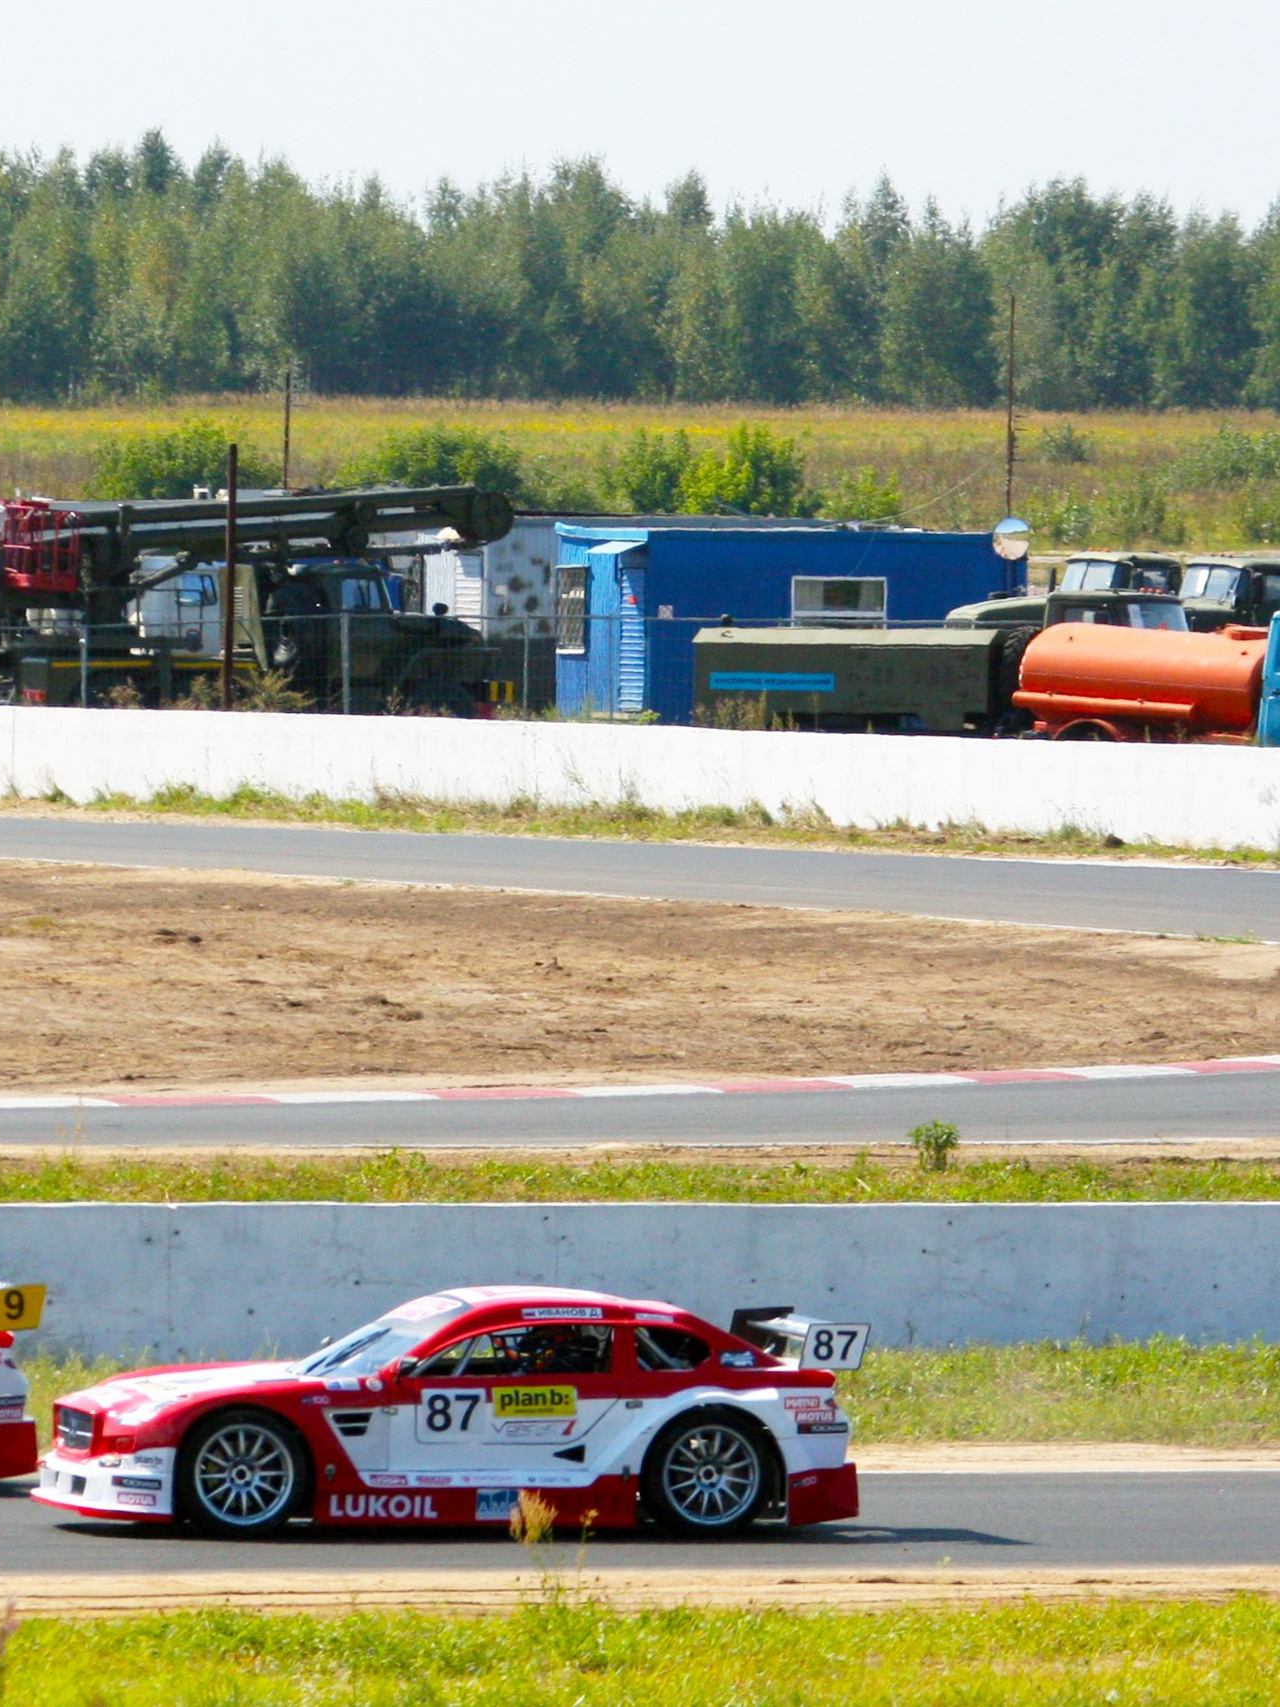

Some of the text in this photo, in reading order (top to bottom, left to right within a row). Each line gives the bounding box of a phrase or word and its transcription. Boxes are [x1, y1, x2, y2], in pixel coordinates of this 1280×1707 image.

[4, 1289, 24, 1320] 9
[538, 1309, 586, 1317] ИВАНОВ
[813, 1329, 859, 1361] 87
[500, 1390, 546, 1410] plan
[426, 1393, 481, 1432] 87
[796, 1410, 834, 1422] MOTUL
[329, 1494, 438, 1518] LUKOIL
